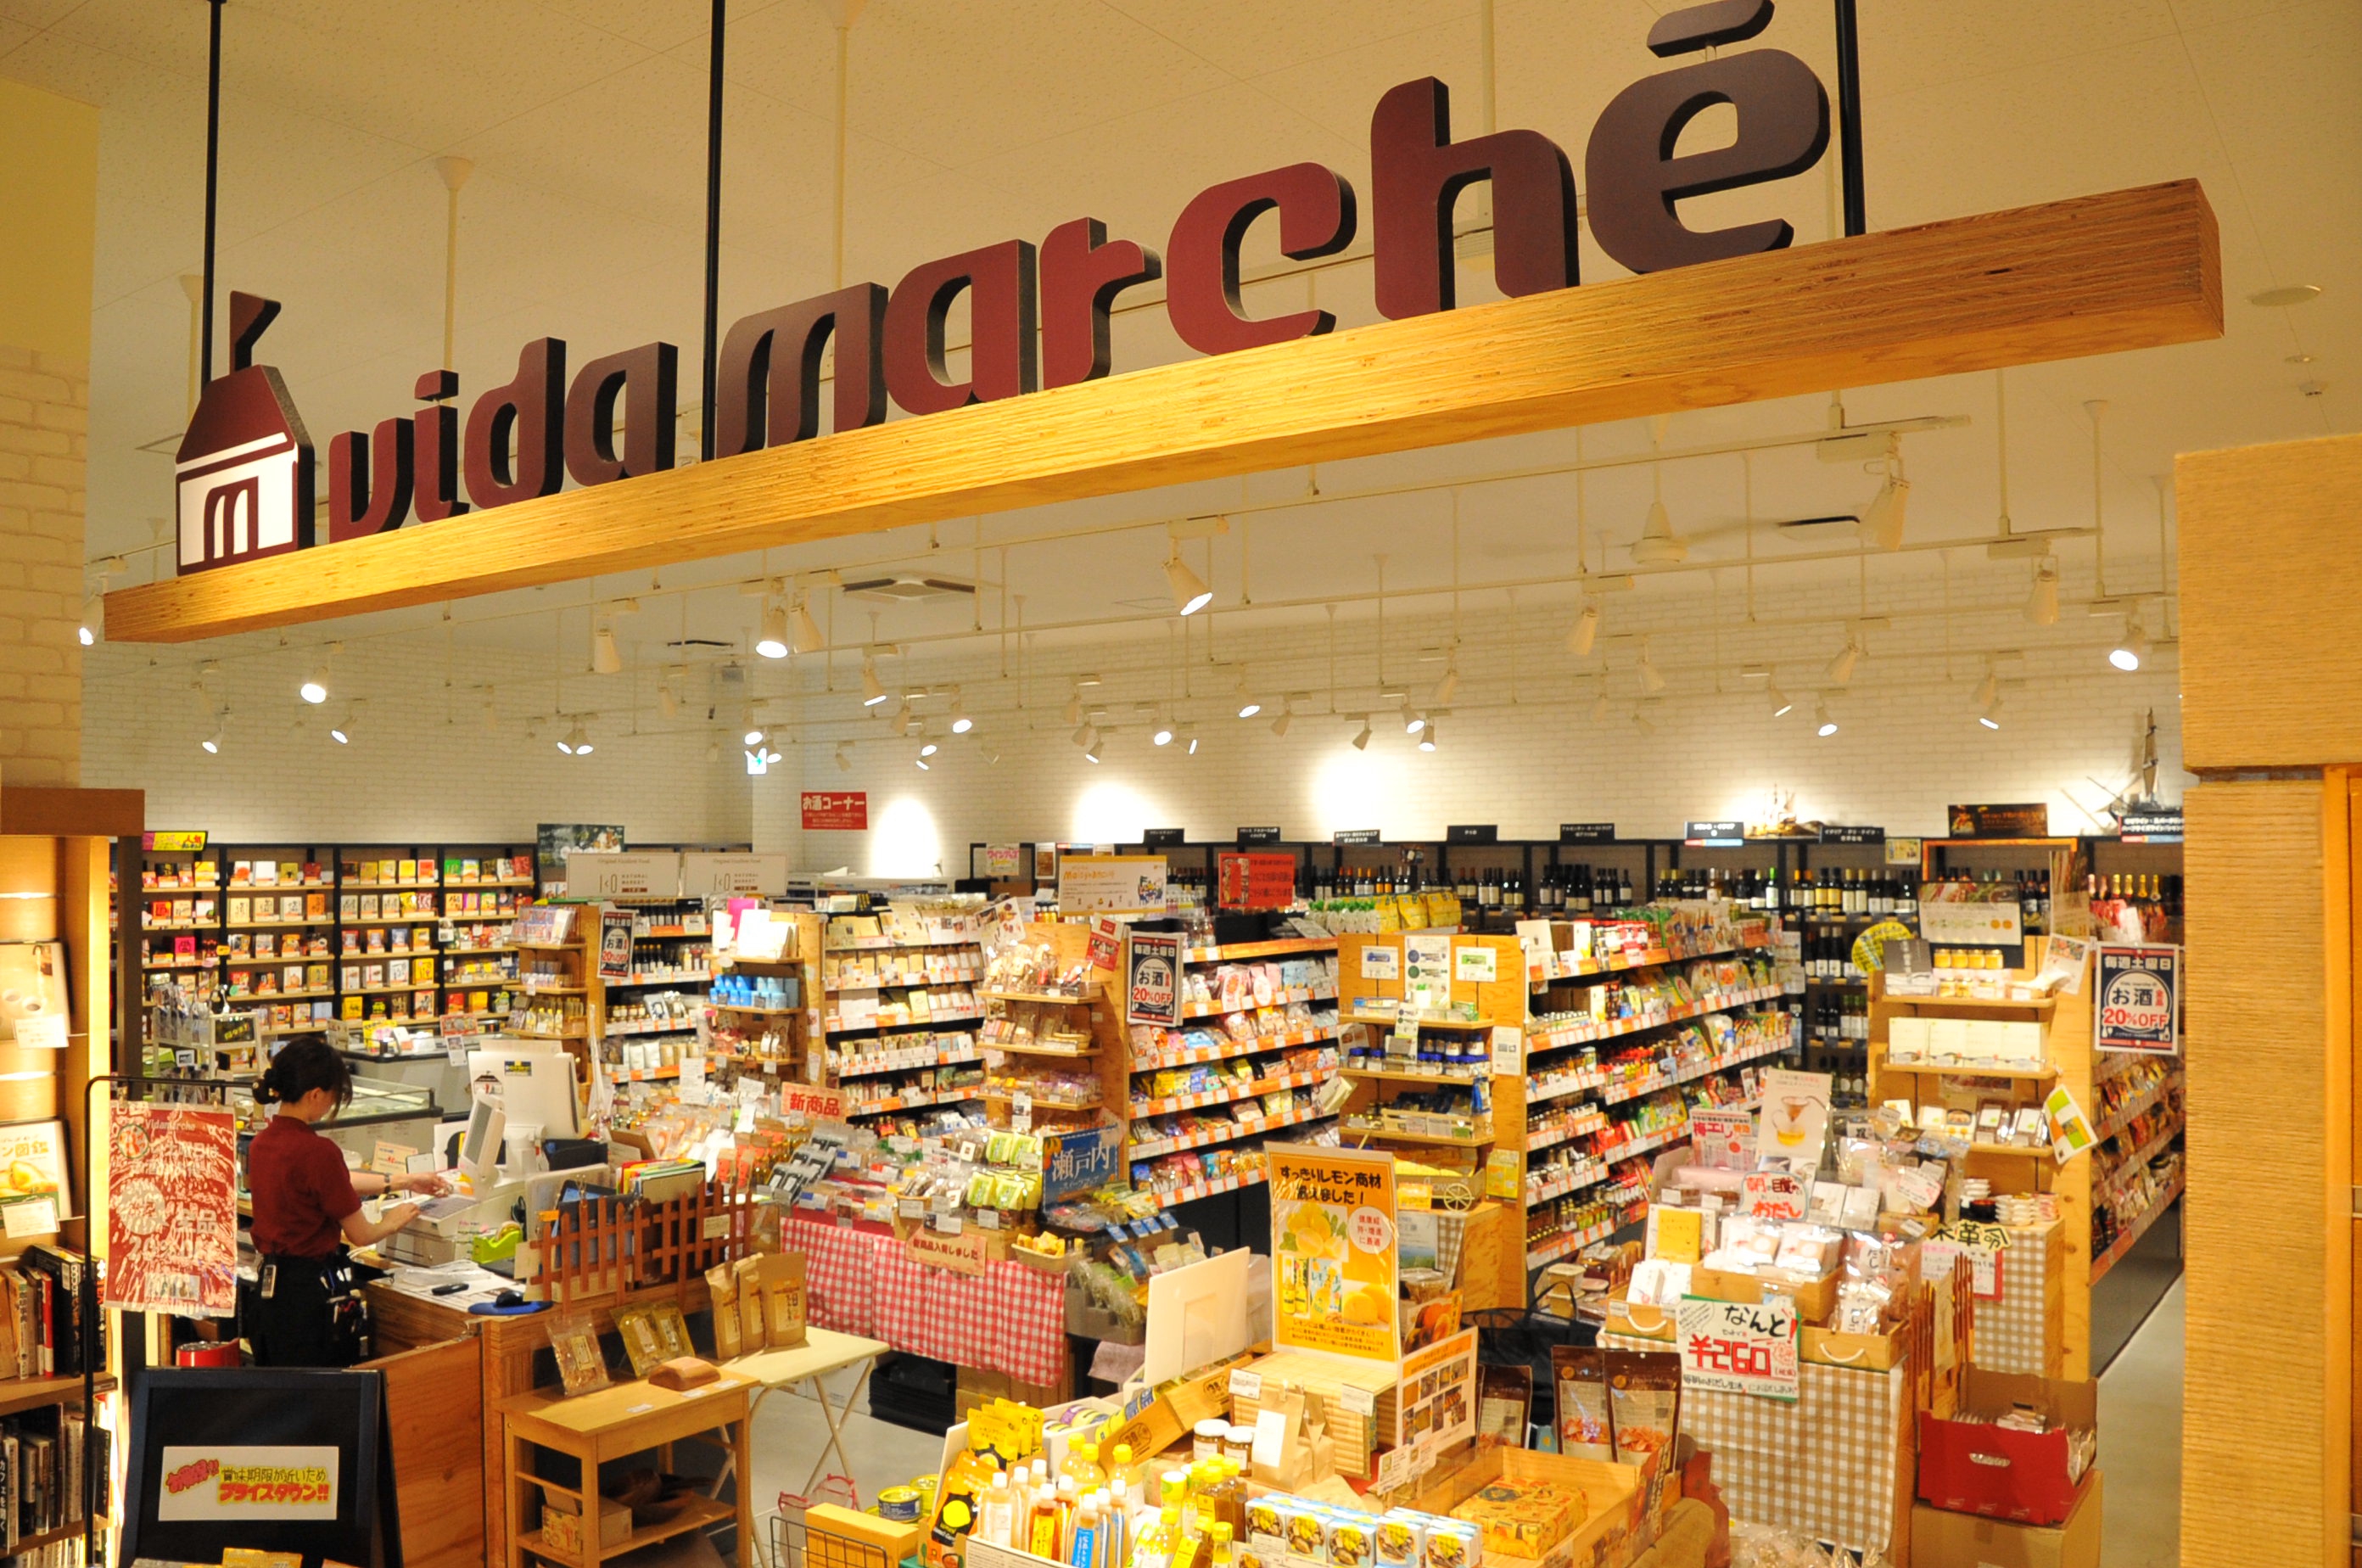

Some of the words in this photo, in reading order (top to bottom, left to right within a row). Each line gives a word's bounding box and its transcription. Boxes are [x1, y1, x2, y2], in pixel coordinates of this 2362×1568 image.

[329, 337, 678, 543] vida
[803, 795, 865, 810] お酒コーナー
[1134, 944, 1175, 957] 毎週土曜日
[2104, 955, 2172, 971] 毎週土曜日
[1139, 970, 1164, 987] お酒
[1133, 987, 1173, 1004] 20%OFF
[2112, 987, 2153, 1006] お酒
[2103, 1007, 2168, 1028] 20%OFF
[790, 1093, 840, 1116] 新商品
[1052, 1141, 1110, 1182] 瀬戸内
[1279, 1166, 1381, 1189] すっきりレモン商材
[1752, 1201, 1802, 1219] おだし
[913, 1239, 979, 1261] 新商品入荷しました
[1688, 1334, 1772, 1376] ¥260
[221, 1468, 327, 1482] 賞味期限が近いため
[220, 1483, 330, 1502] プライスダウン!!
